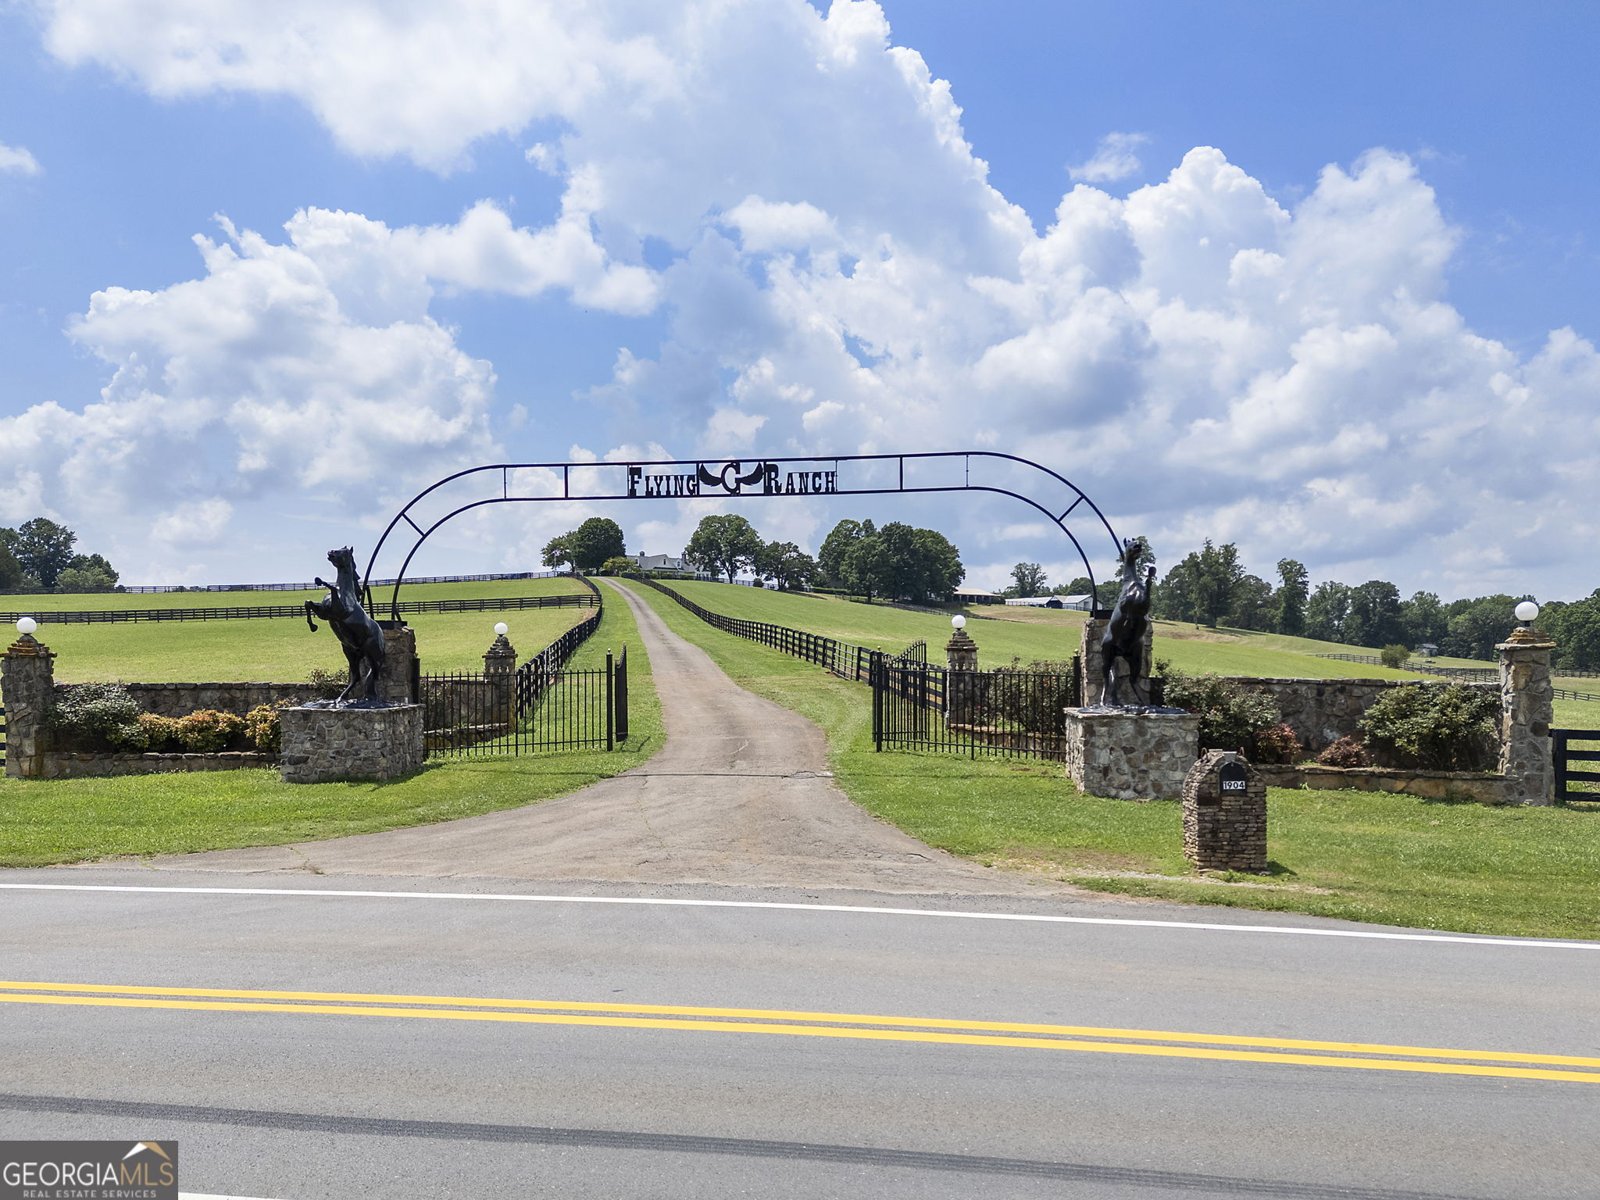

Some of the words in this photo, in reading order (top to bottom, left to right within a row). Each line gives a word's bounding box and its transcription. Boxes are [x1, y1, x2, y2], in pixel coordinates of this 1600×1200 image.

[629, 466, 697, 496] FLYING
[764, 463, 837, 494] RANCH
[1223, 781, 1245, 789] 1904
